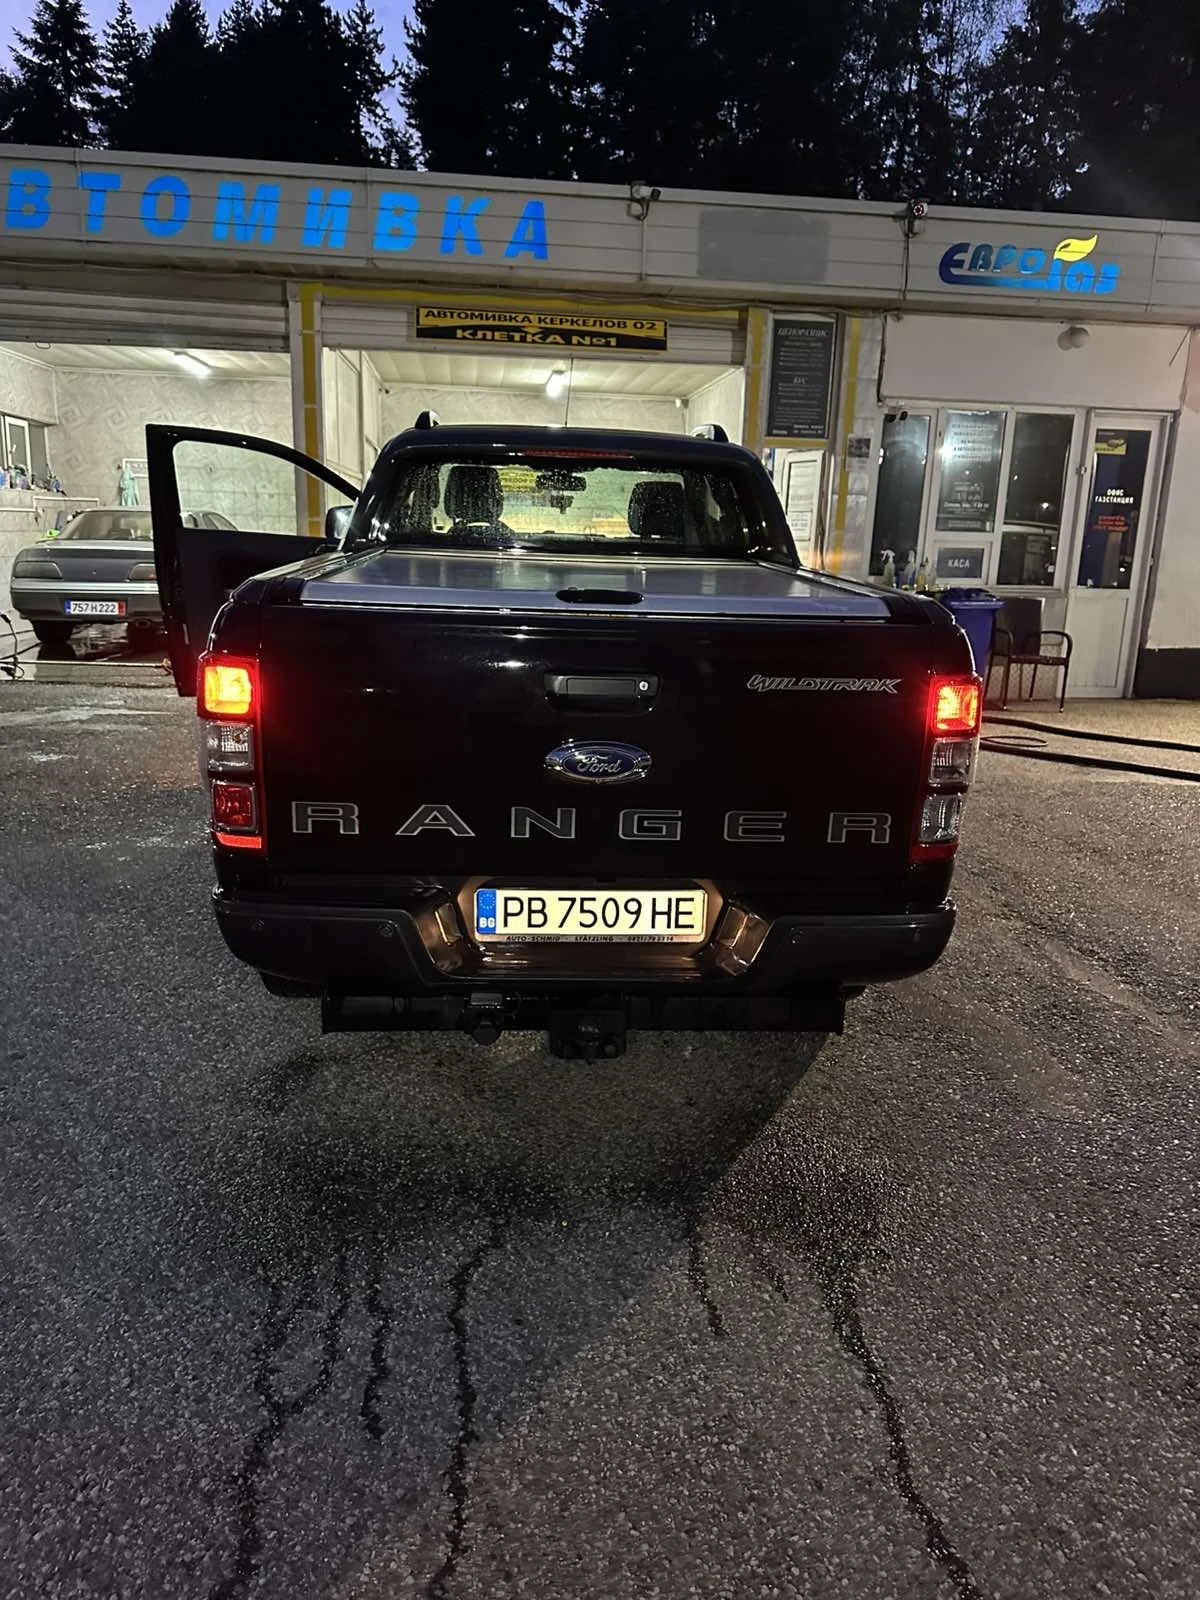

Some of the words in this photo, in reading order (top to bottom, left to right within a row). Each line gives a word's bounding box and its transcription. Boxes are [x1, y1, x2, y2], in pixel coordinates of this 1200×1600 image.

[424, 309, 532, 324] АВТОМИВКА
[537, 316, 628, 329] КЕРКЕЛОВ
[456, 329, 565, 344] КЛЕТКА
[947, 559, 970, 569] КАСА
[72, 602, 89, 613] 757
[99, 603, 116, 613] 222
[747, 674, 902, 694] WILDTRAK
[576, 752, 622, 773] Ford
[291, 801, 892, 844] RANGER
[479, 917, 496, 928] BG
[503, 896, 548, 928] PB
[558, 897, 642, 929] 7509
[651, 897, 695, 929] HE
